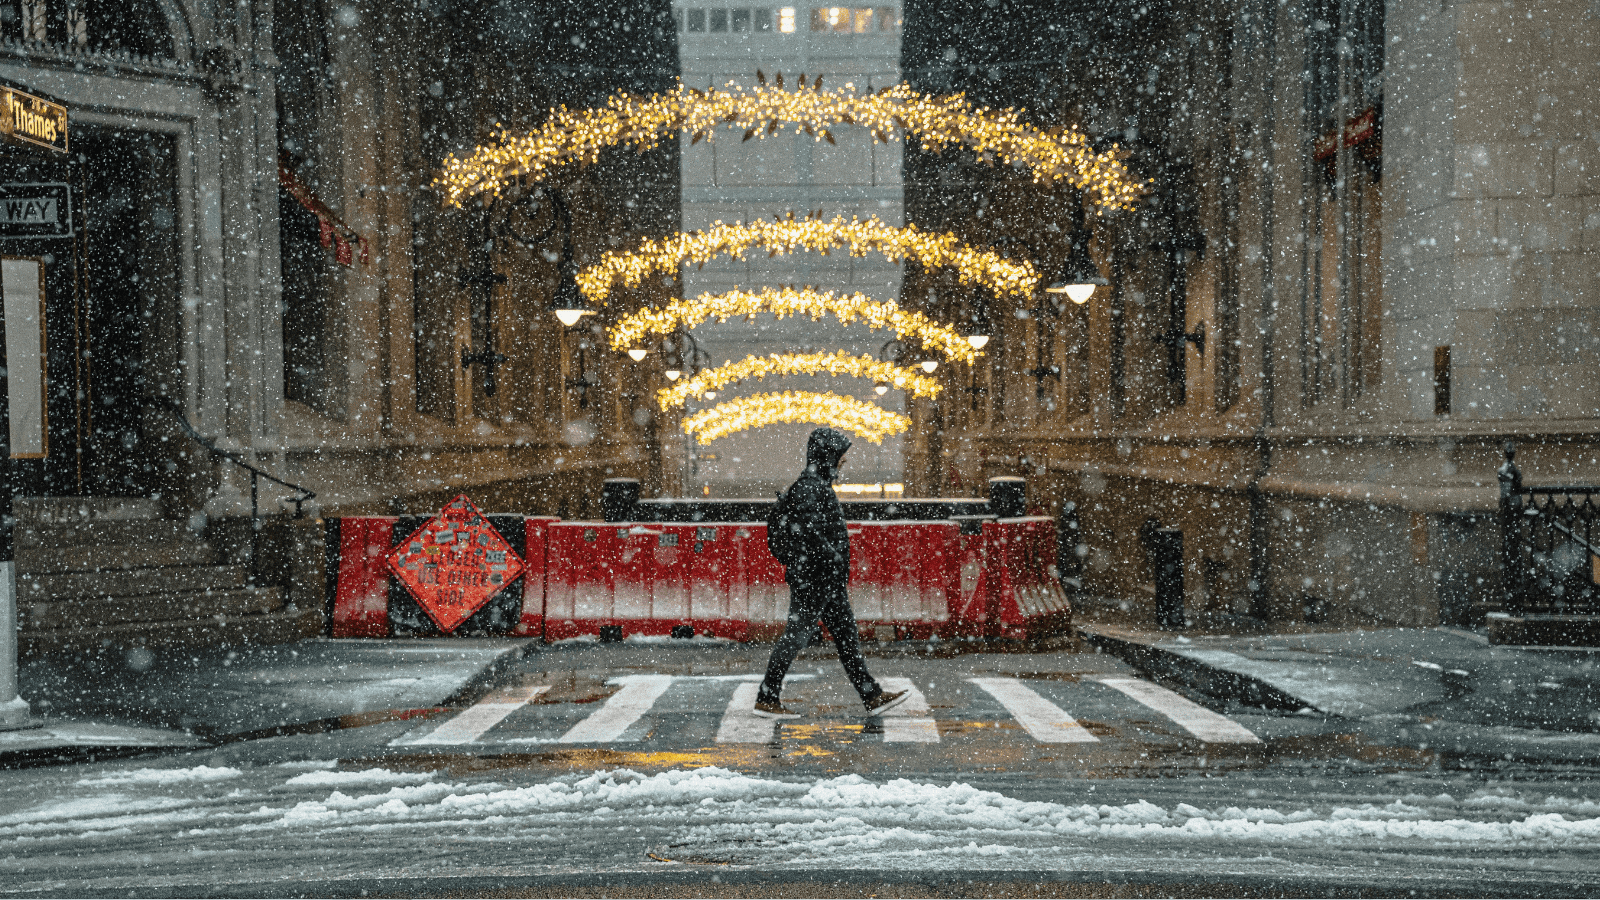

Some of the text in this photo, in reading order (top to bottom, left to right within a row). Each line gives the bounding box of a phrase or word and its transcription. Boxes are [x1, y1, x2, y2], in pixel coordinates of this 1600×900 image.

[14, 100, 57, 142] Thames
[5, 200, 50, 221] WAY
[417, 567, 488, 587] USE OTHER
[436, 588, 466, 606] SIDE
